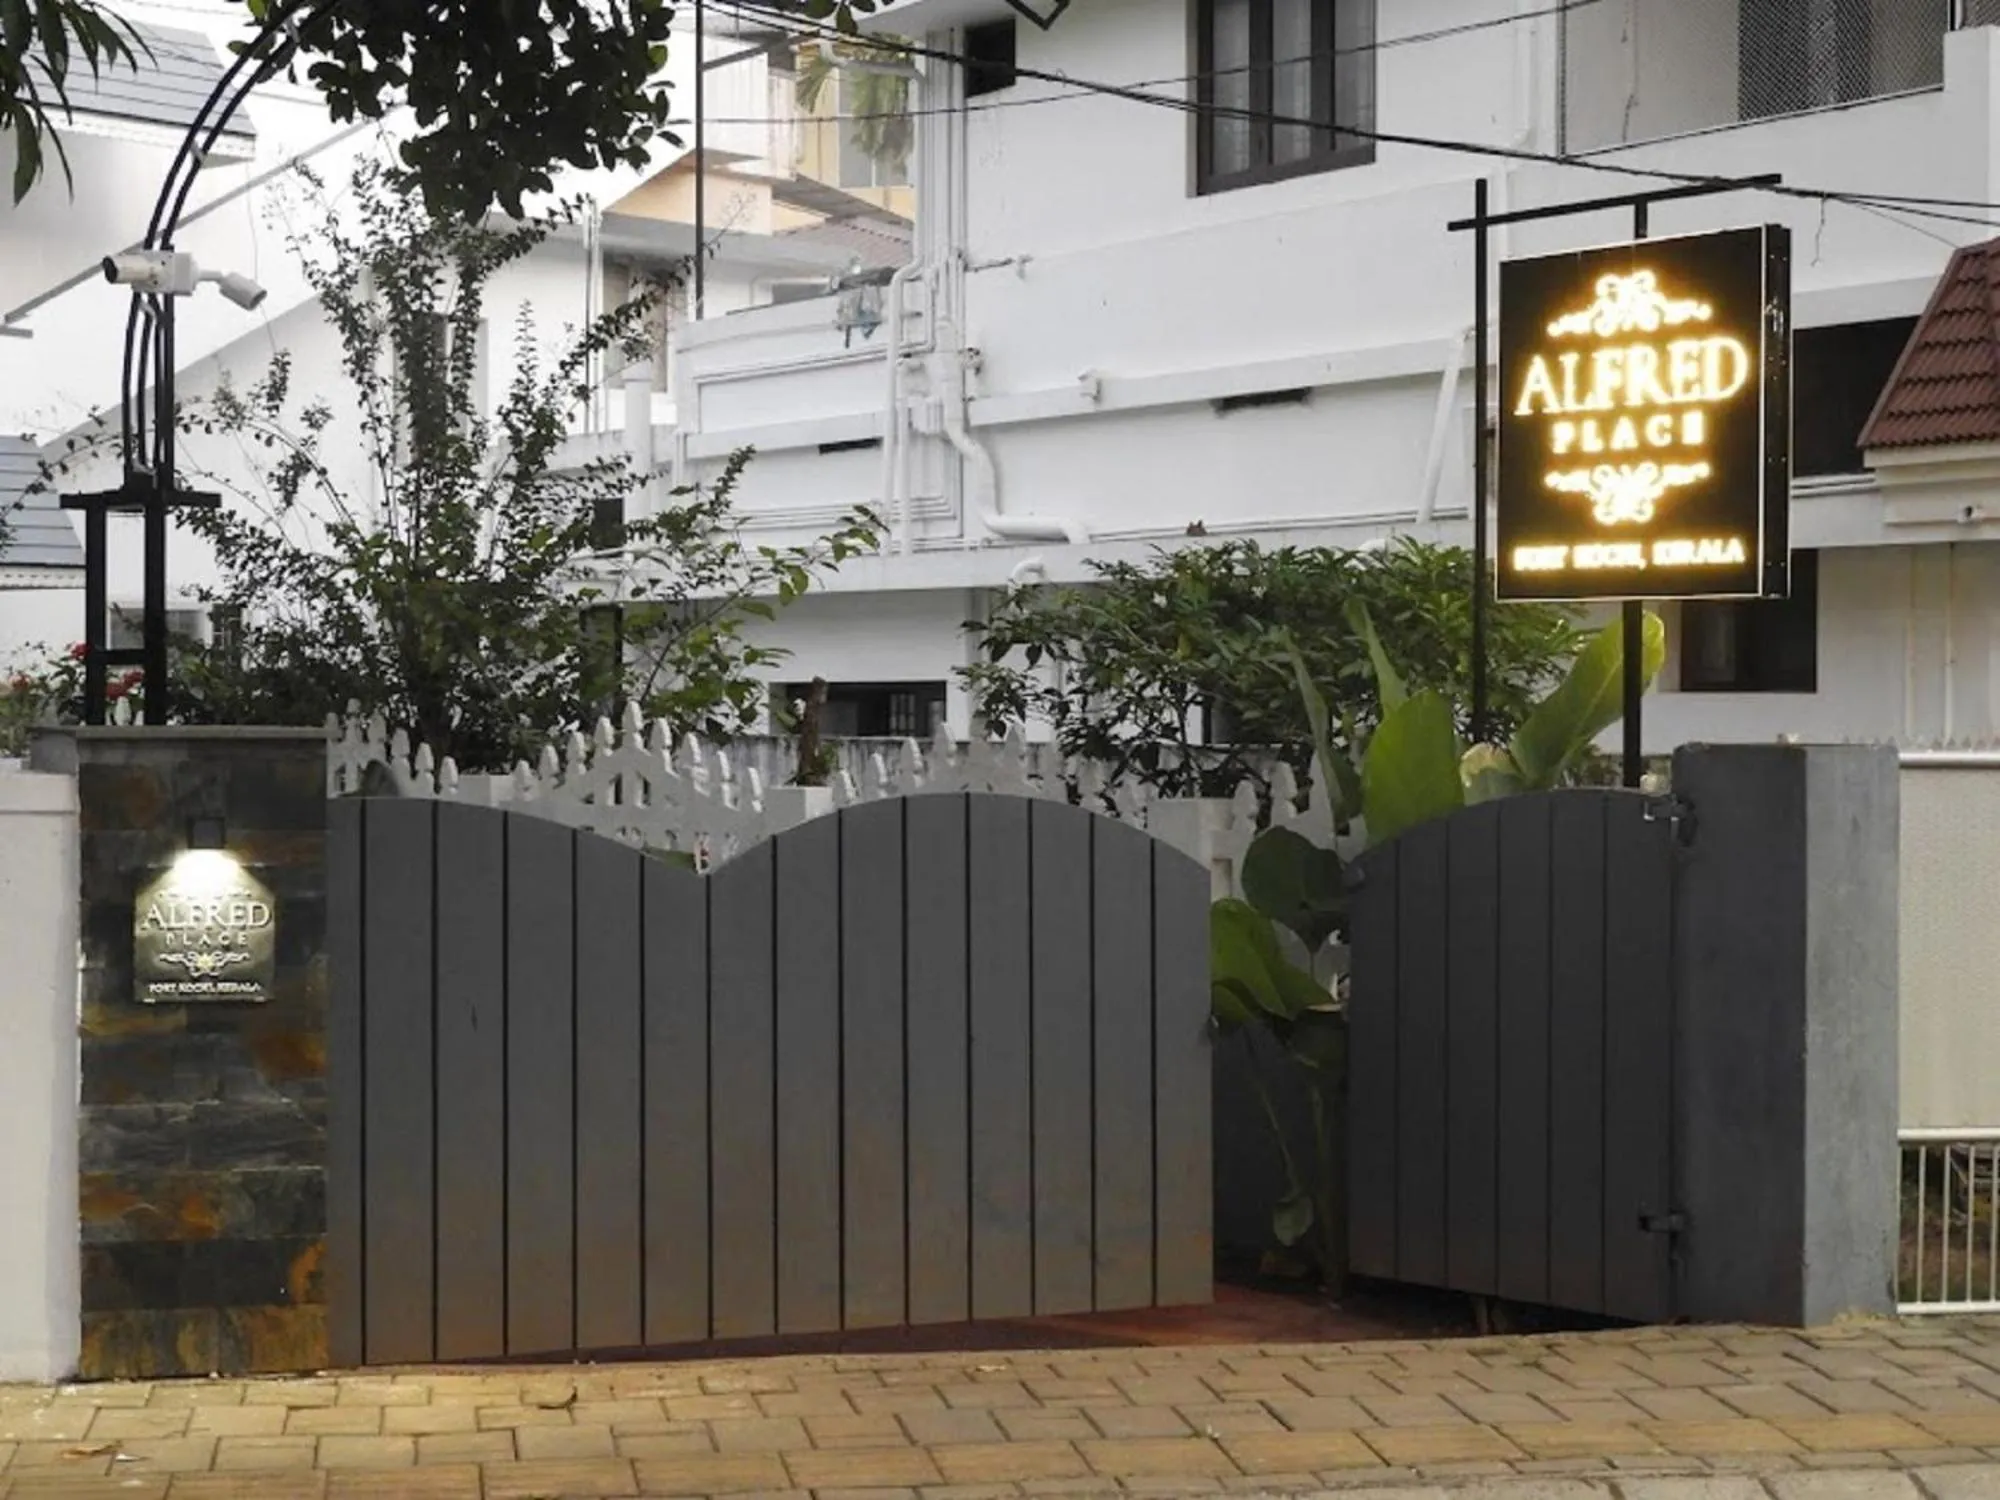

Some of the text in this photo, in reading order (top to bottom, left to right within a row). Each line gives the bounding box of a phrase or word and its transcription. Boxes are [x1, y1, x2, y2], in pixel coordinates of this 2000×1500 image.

[1514, 337, 1749, 415] ALFRED
[1552, 411, 1705, 454] PLACE
[142, 902, 272, 930] ALFRED
[166, 932, 249, 946] PLACE
